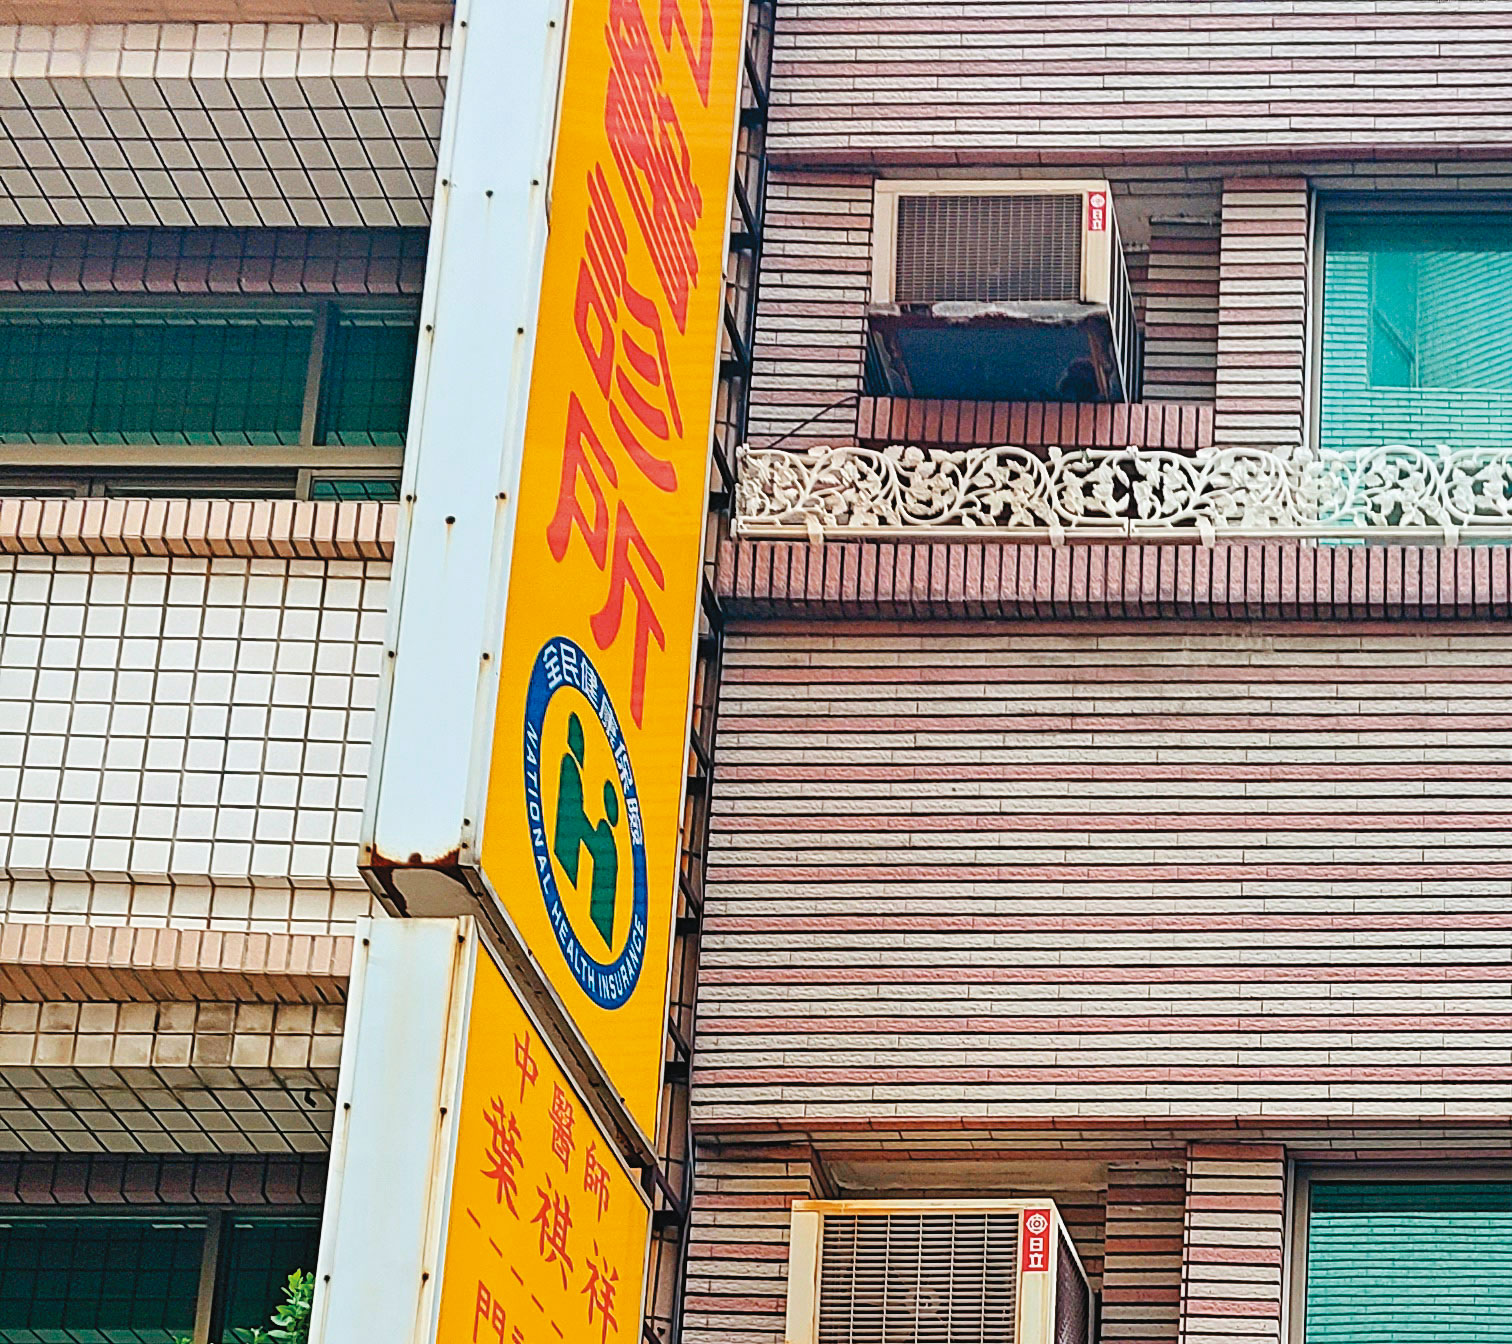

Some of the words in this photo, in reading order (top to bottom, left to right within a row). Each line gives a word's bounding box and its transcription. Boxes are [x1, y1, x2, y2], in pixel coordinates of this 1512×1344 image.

[547, 0, 712, 730] 醫診所
[543, 642, 644, 846] 全民健康保險
[526, 719, 553, 899] NATIONAL
[551, 900, 596, 992] HEALTH
[598, 916, 645, 1000] INSURANCE
[514, 1029, 611, 1222] 中醫師
[1028, 1237, 1044, 1268] 日立
